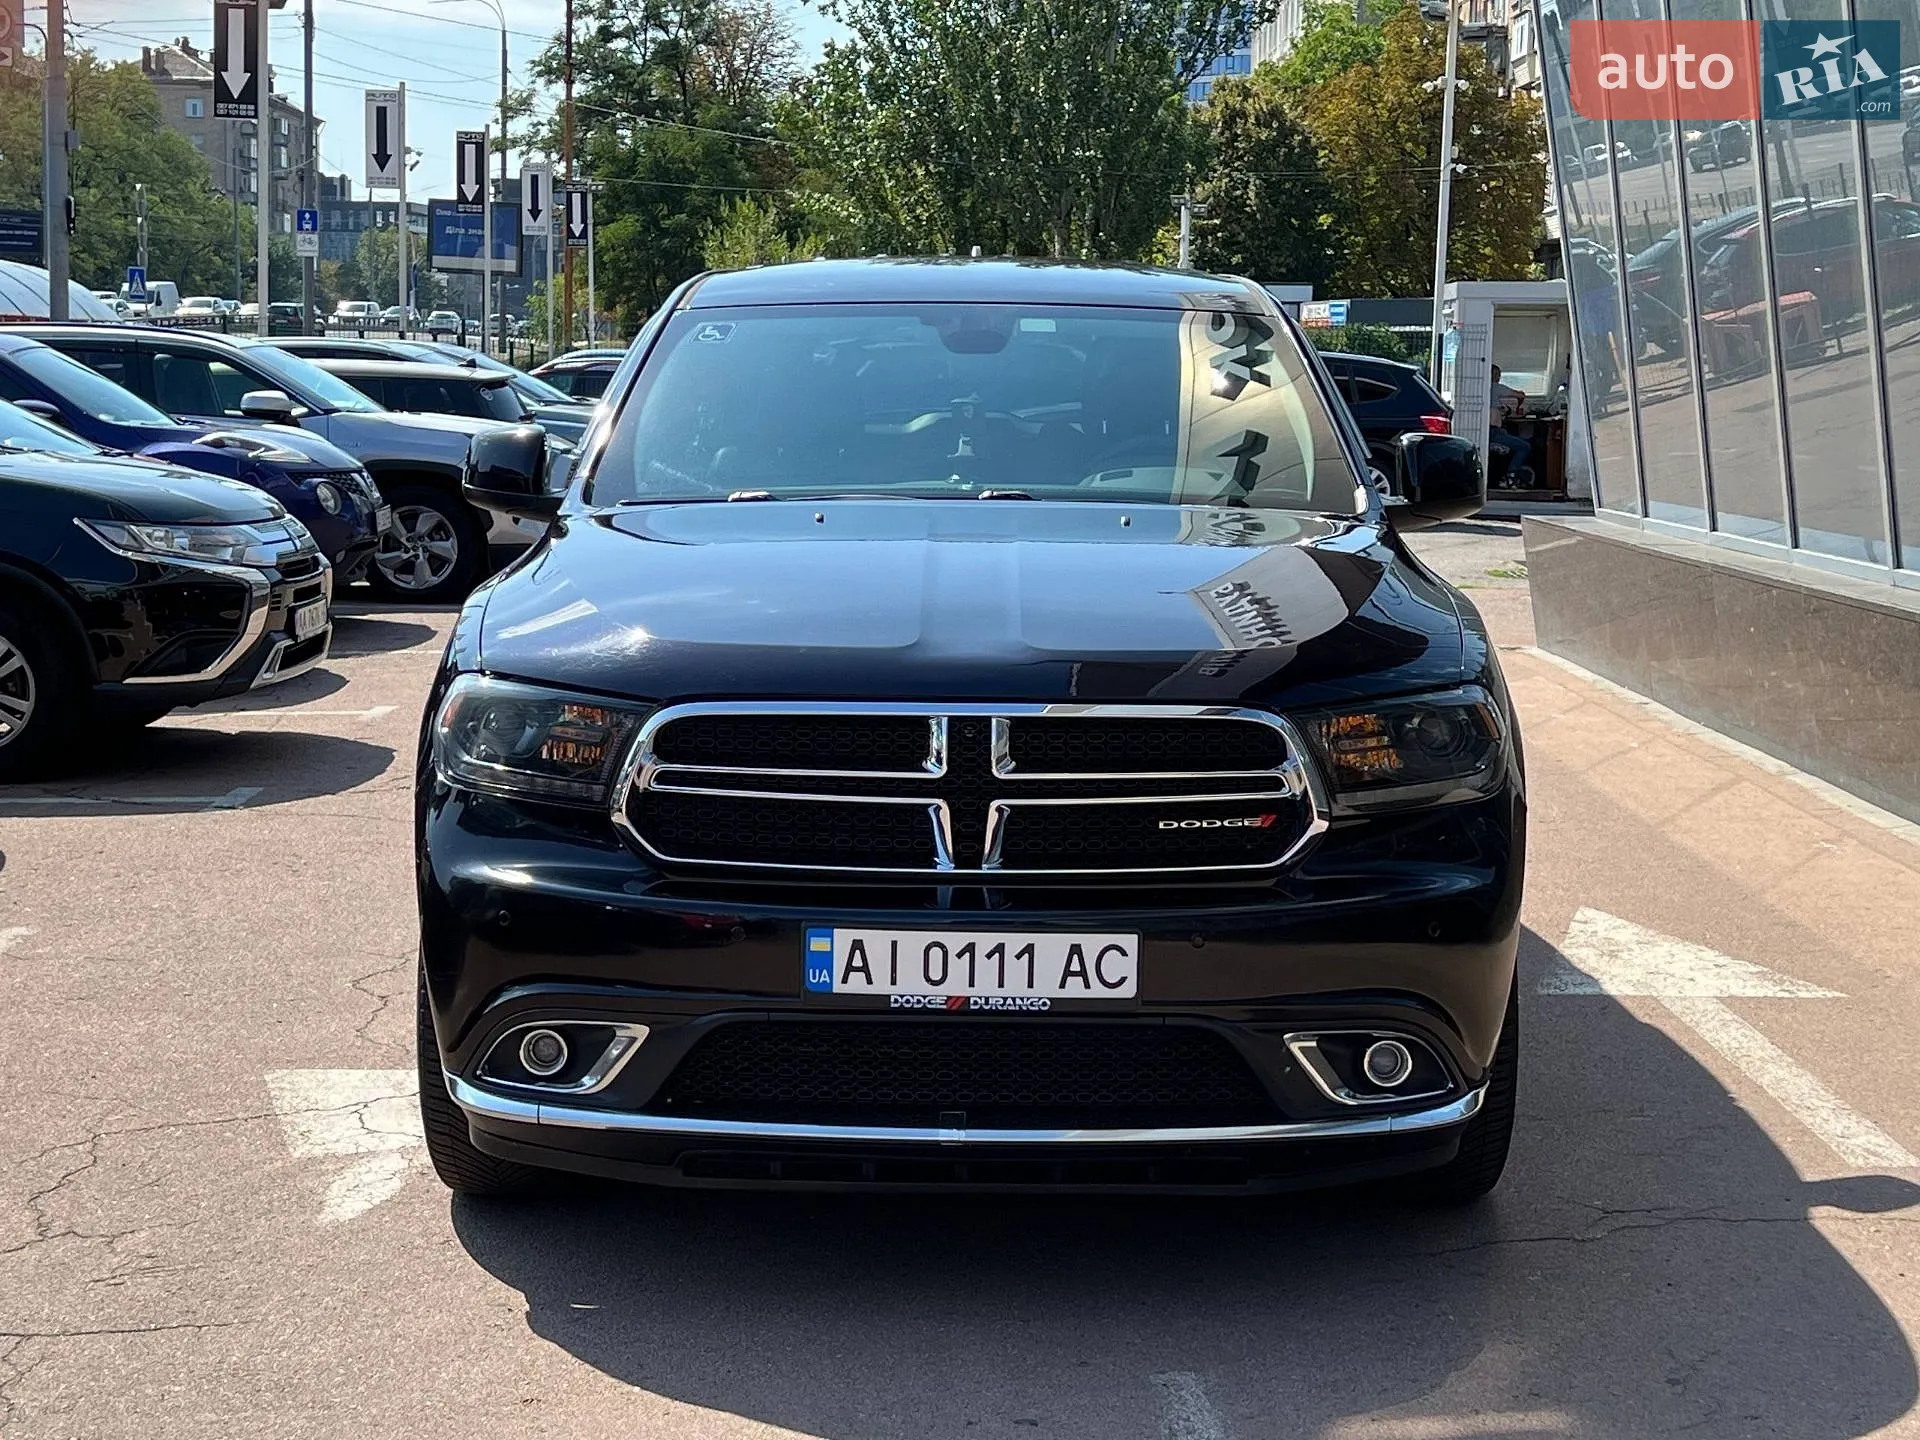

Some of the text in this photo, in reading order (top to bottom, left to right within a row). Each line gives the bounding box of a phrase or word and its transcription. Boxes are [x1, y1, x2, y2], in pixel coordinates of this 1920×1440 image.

[1158, 817, 1262, 829] DODGE
[841, 938, 1130, 990] AI 0111 AC
[808, 968, 831, 984] UA
[890, 994, 1051, 1011] DODGE DURANGO
